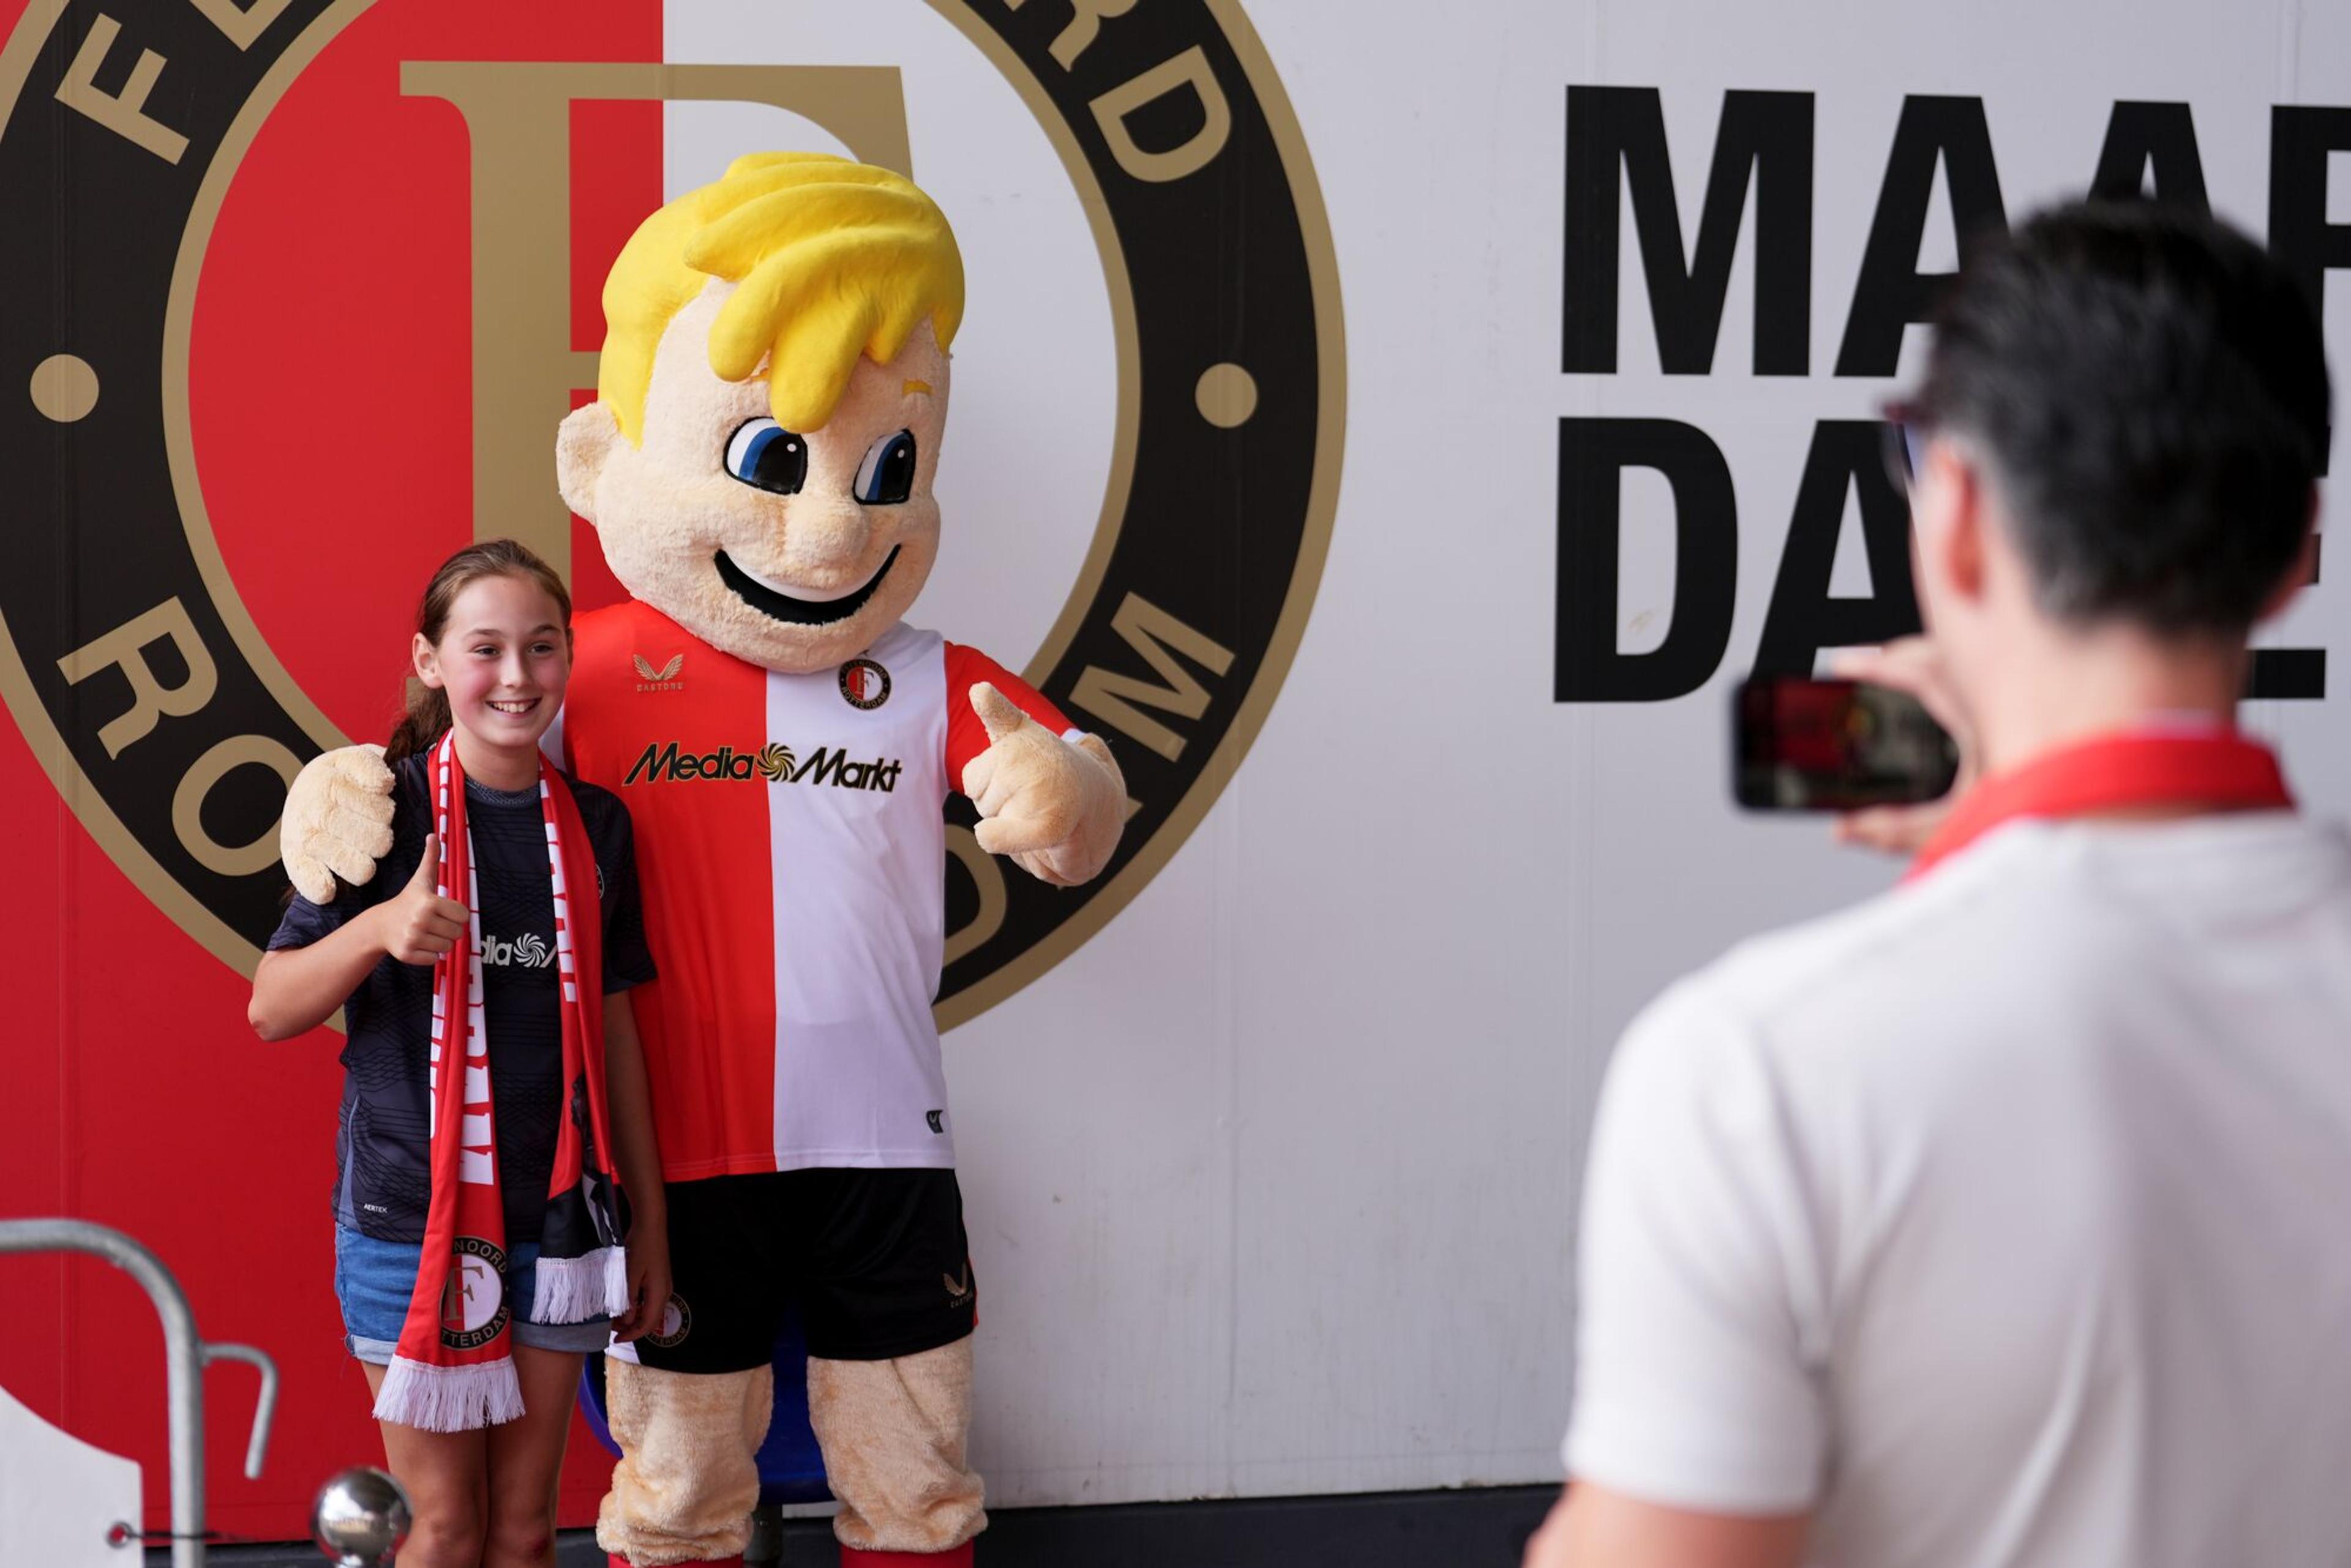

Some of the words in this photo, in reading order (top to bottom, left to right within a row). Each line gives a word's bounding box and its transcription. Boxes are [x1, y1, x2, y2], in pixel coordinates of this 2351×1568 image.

[622, 741, 754, 787] Media
[795, 746, 902, 793] Markt
[481, 934, 513, 967] dia
[454, 1240, 508, 1274] NOORD
[444, 1306, 508, 1346] TERDAM
